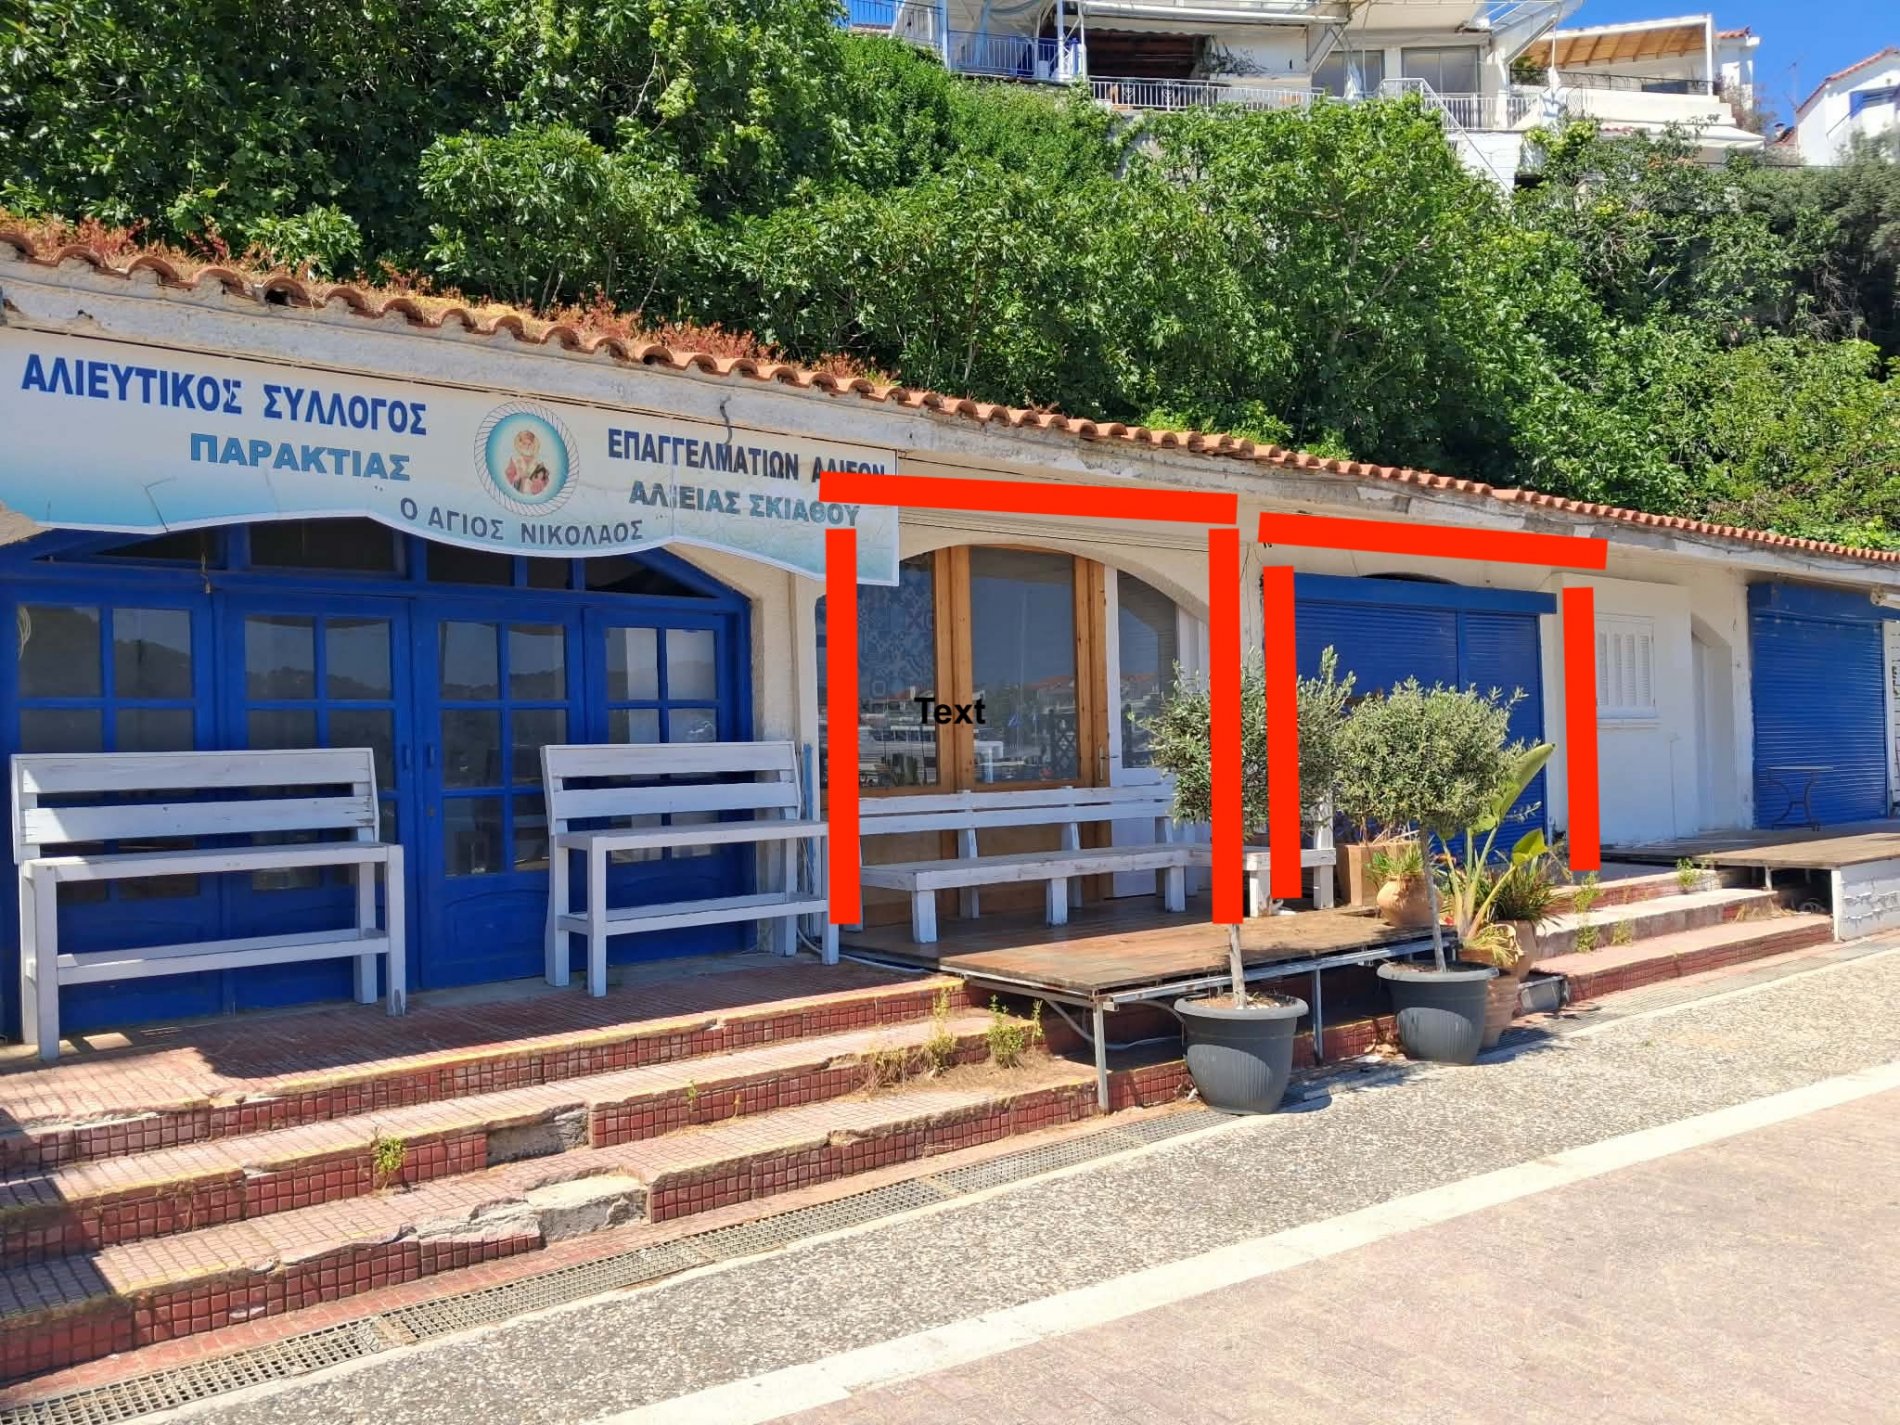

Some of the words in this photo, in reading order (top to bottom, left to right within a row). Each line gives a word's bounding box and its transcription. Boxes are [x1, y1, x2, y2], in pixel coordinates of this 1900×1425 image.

[21, 353, 243, 415] ΑΛΙΕΥΤΙΚΟΣ
[263, 383, 428, 435] ΣΥΛΛΟΓΟΣ
[190, 432, 411, 482] ΠΑΡΑΚΤΙΑΣ
[608, 427, 799, 481] ΕΠΑΓΓΕΛΜΑΤΙΩΝ
[400, 497, 419, 521] Ο
[428, 506, 504, 541] ΑΓΙΟΣ
[521, 519, 643, 546] ΝΙΚΟΛΑΟΣ
[629, 480, 741, 515] ΑΛΙΕΙΑΣ
[748, 493, 860, 527] ΣΚΙΑΘΟΥ
